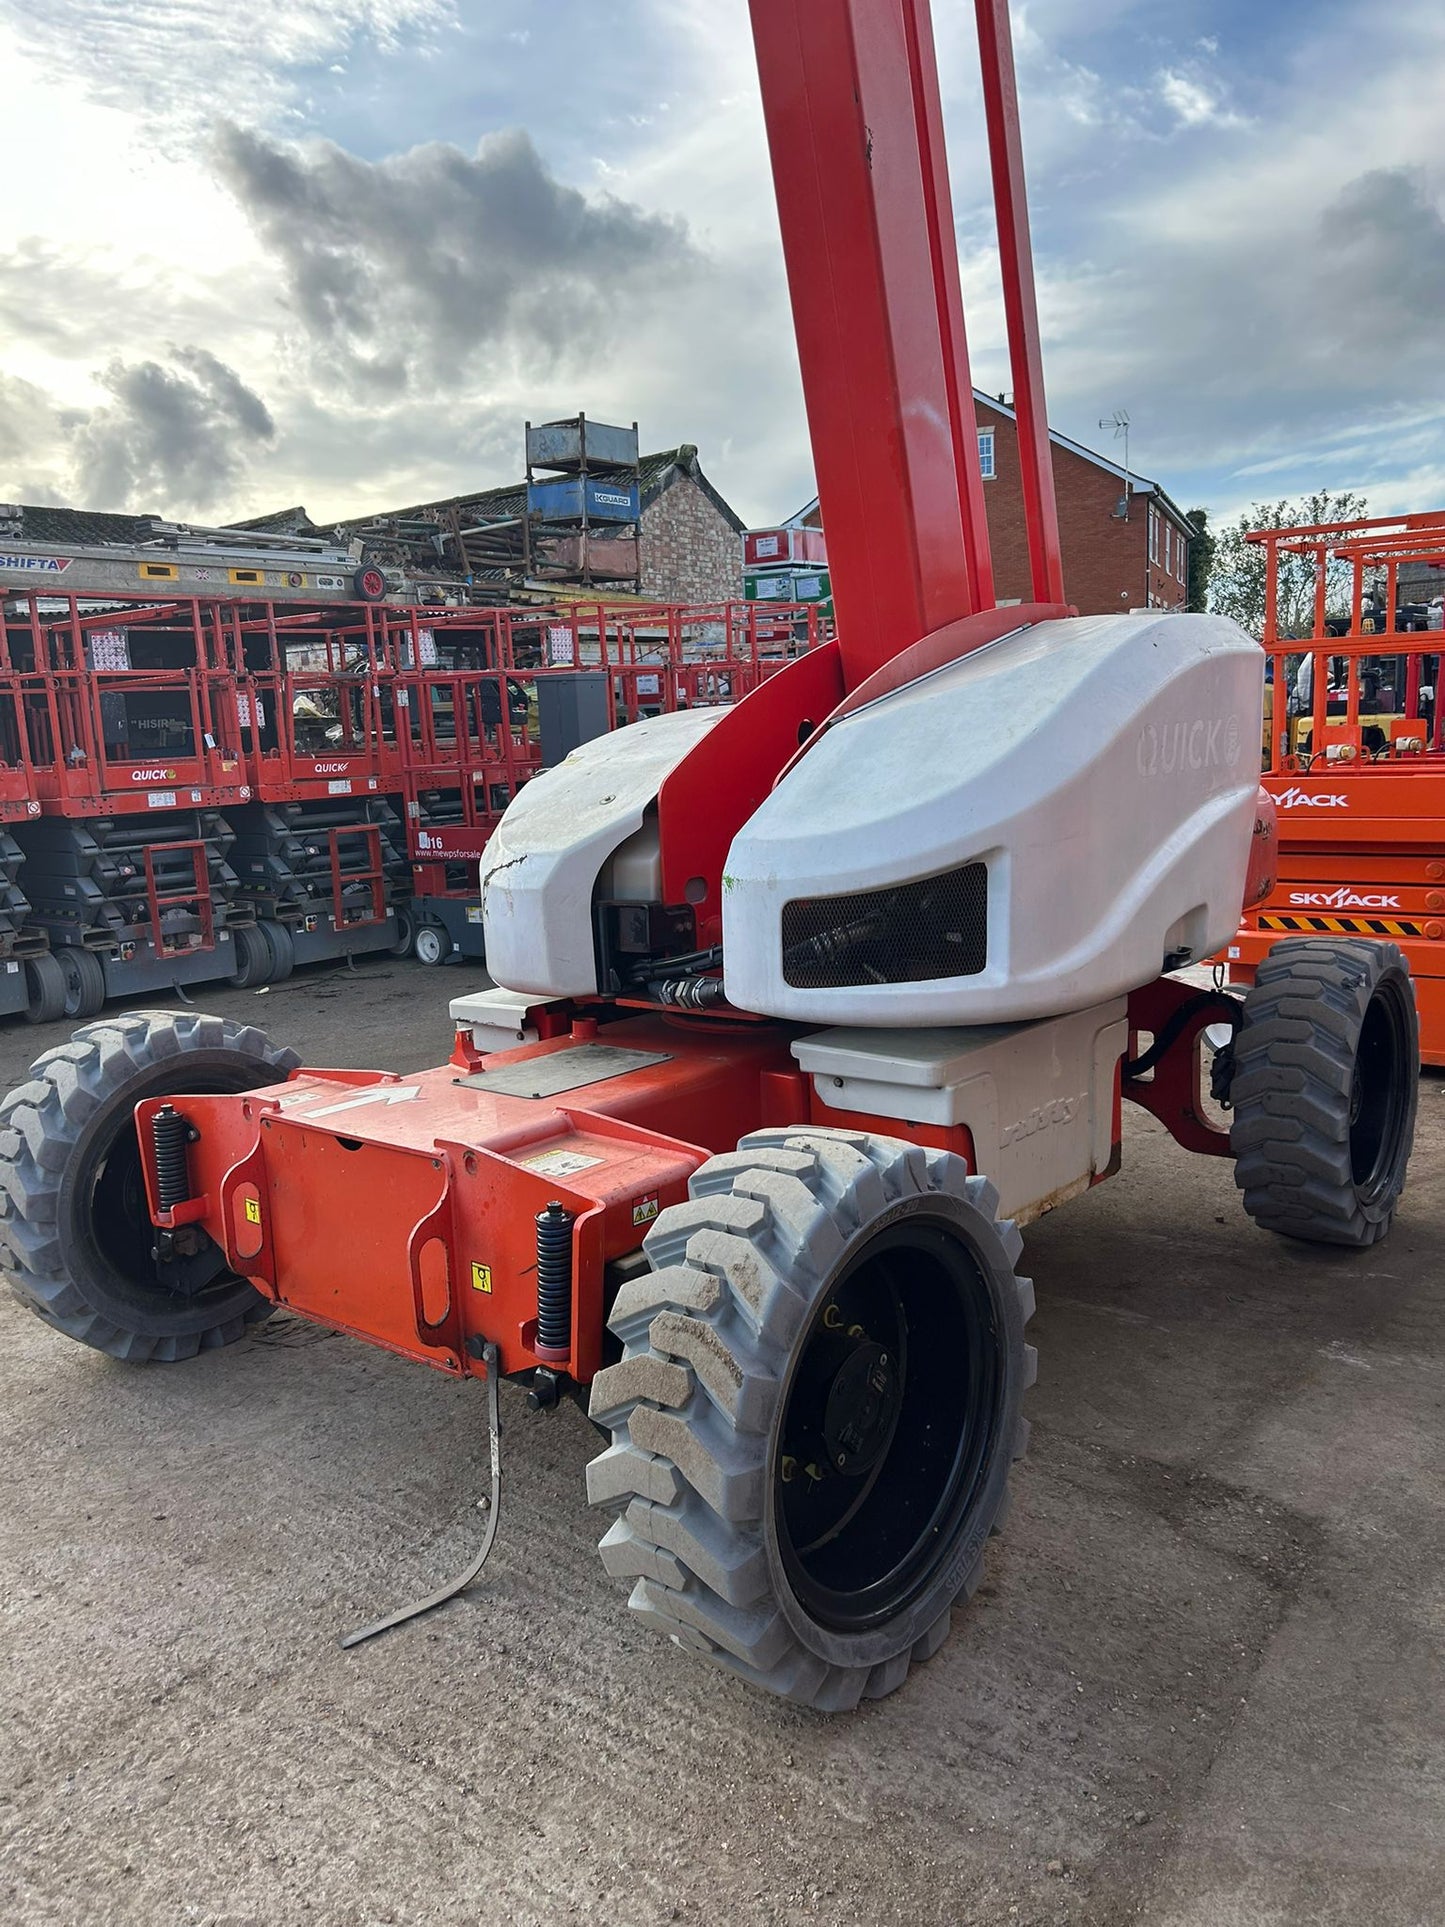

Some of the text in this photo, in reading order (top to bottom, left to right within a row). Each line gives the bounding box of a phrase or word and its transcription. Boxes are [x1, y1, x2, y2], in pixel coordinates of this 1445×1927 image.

[0, 556, 59, 570] SHIFTA
[132, 769, 168, 781] QUICK
[1270, 787, 1349, 809] YJACK
[1289, 888, 1401, 908] SKYJACK
